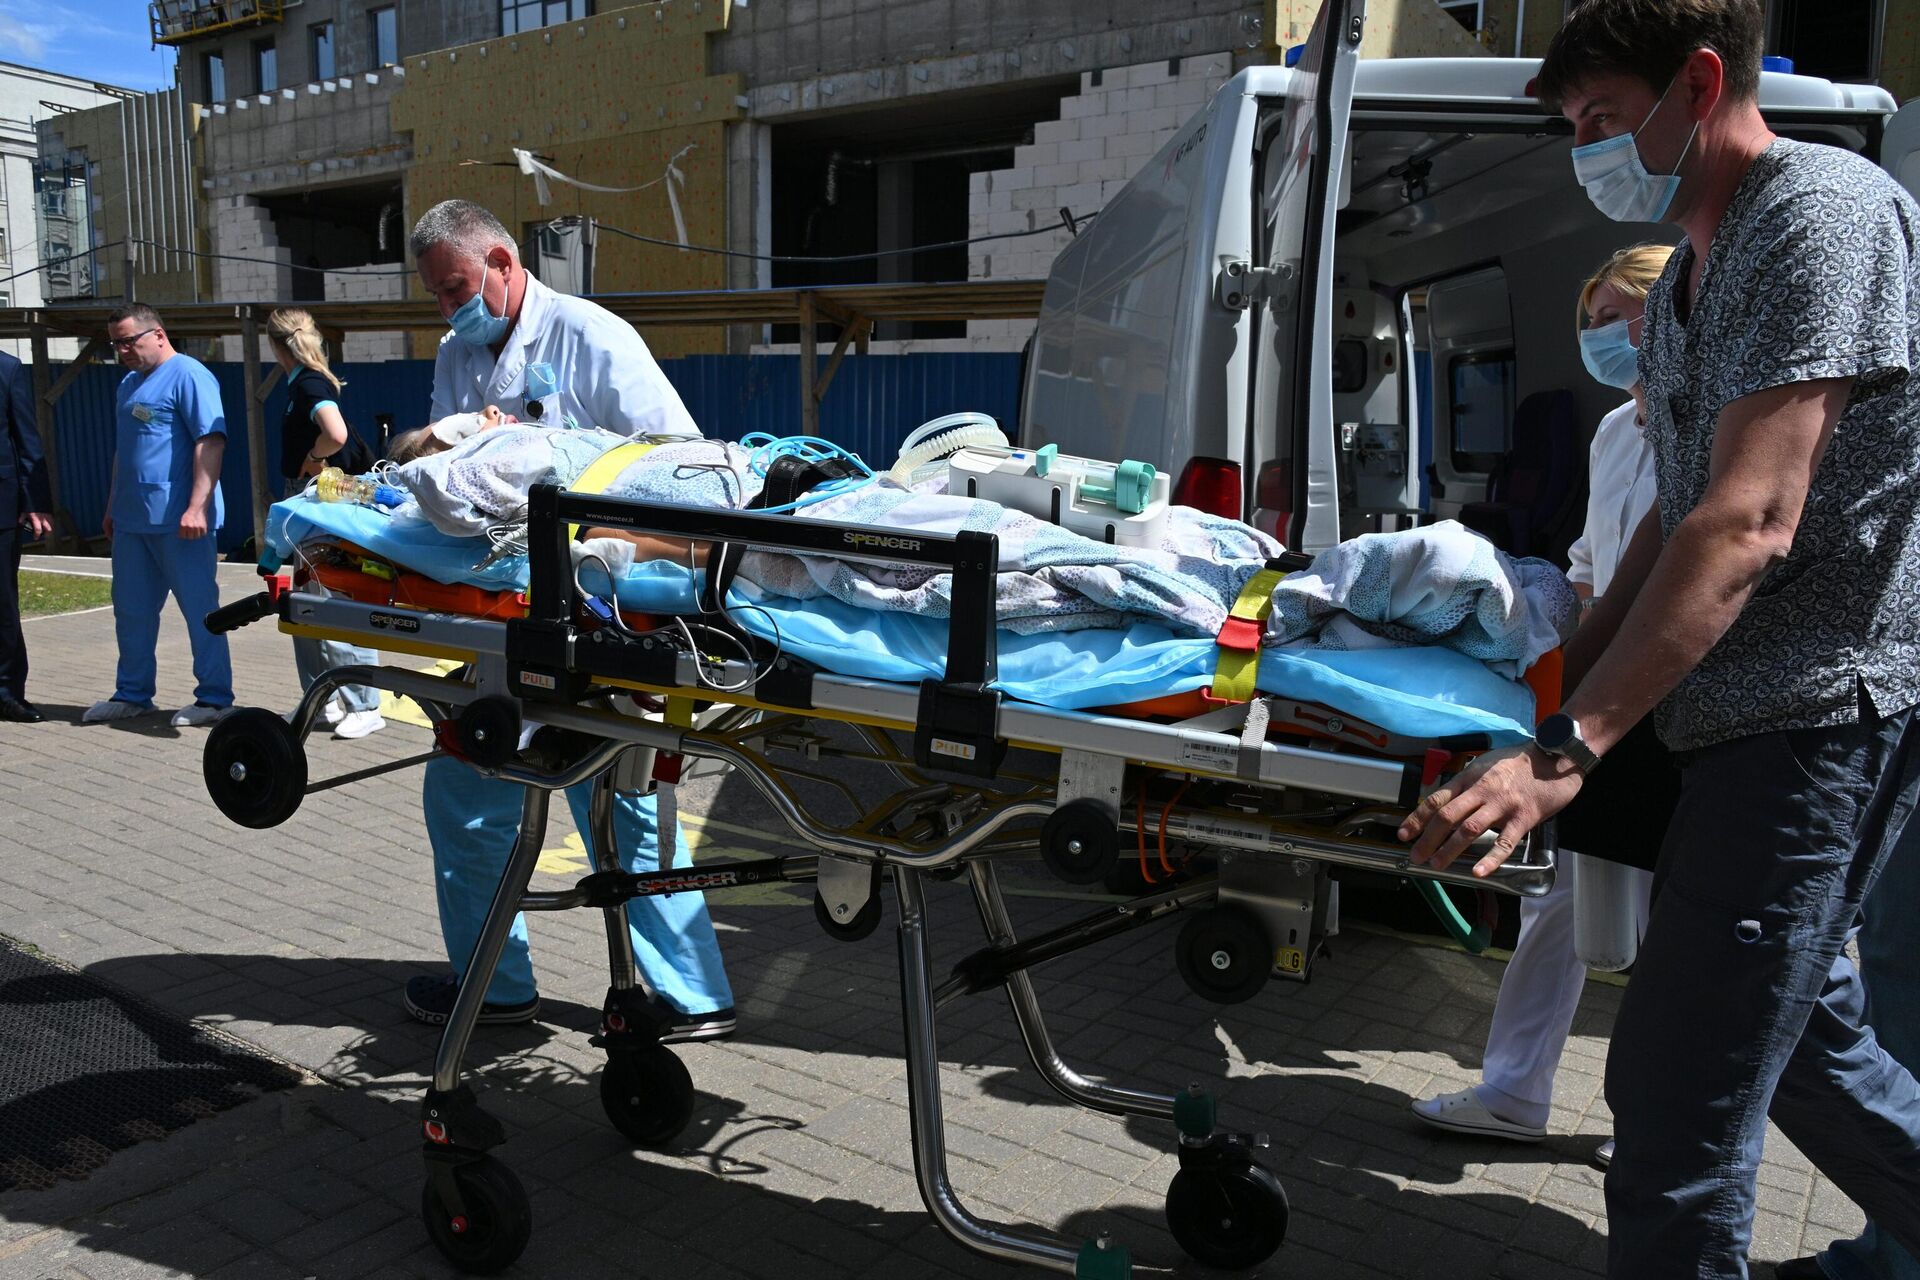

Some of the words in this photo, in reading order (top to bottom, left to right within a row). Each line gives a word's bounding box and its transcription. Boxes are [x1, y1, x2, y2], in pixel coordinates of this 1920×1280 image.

[585, 513, 634, 523] www.spencer.it
[843, 532, 921, 551] SPENCER
[370, 614, 417, 629] SPENCER
[523, 671, 552, 688] PULL
[936, 740, 970, 757] PULL
[636, 871, 737, 894] SPENCER
[415, 1008, 444, 1023] cro
